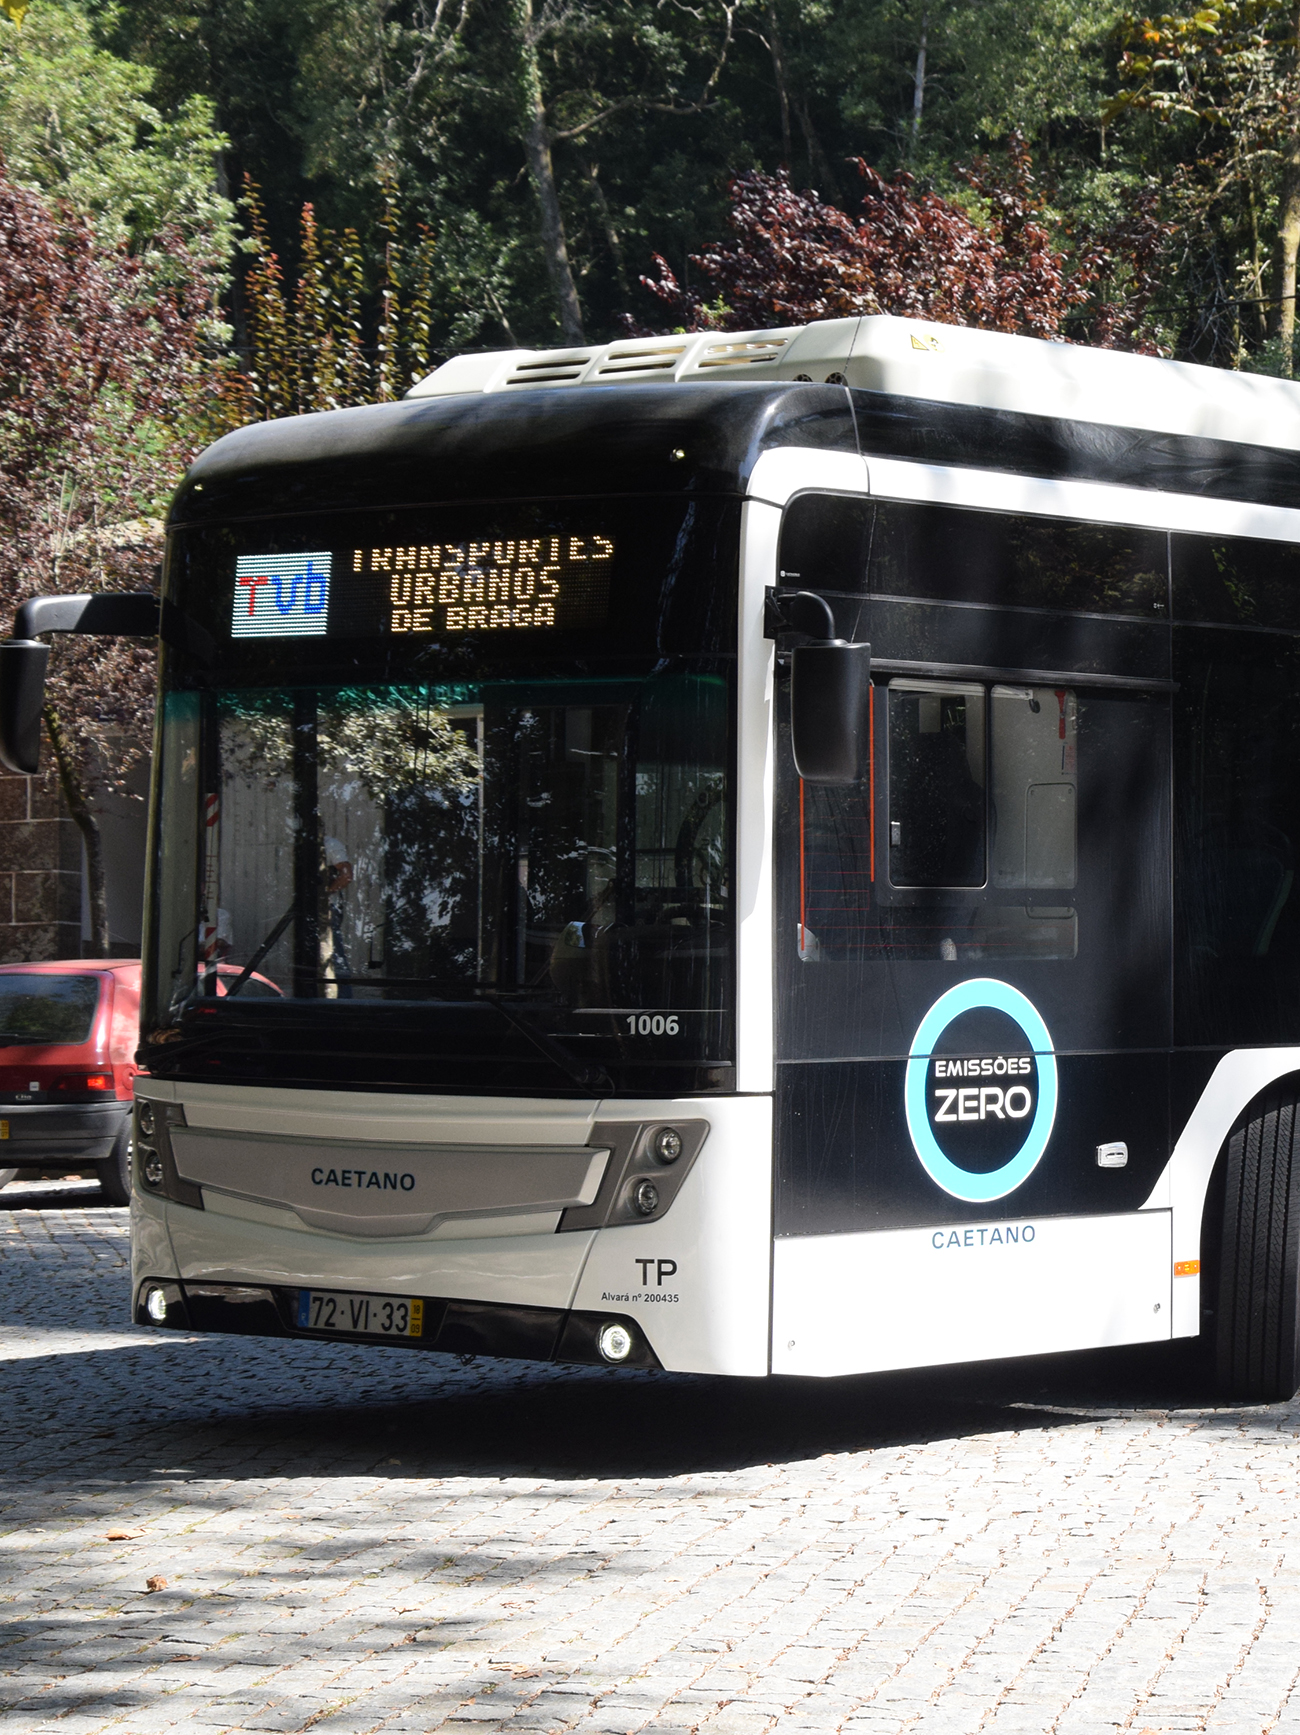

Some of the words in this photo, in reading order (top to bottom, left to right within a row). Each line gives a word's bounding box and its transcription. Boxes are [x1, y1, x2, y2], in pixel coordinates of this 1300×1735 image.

[390, 565, 561, 606] URBANOS
[391, 608, 434, 632] DE
[446, 602, 556, 630] BRAGA
[626, 1015, 680, 1036] 1006
[935, 1056, 1031, 1077] EMISSÕES
[934, 1086, 1032, 1122] ZERO
[310, 1167, 416, 1192] CAETANO
[931, 1225, 1036, 1249] CAETANO
[635, 1258, 678, 1286] TP
[601, 1292, 629, 1303] Alvará
[644, 1294, 680, 1303] 200435
